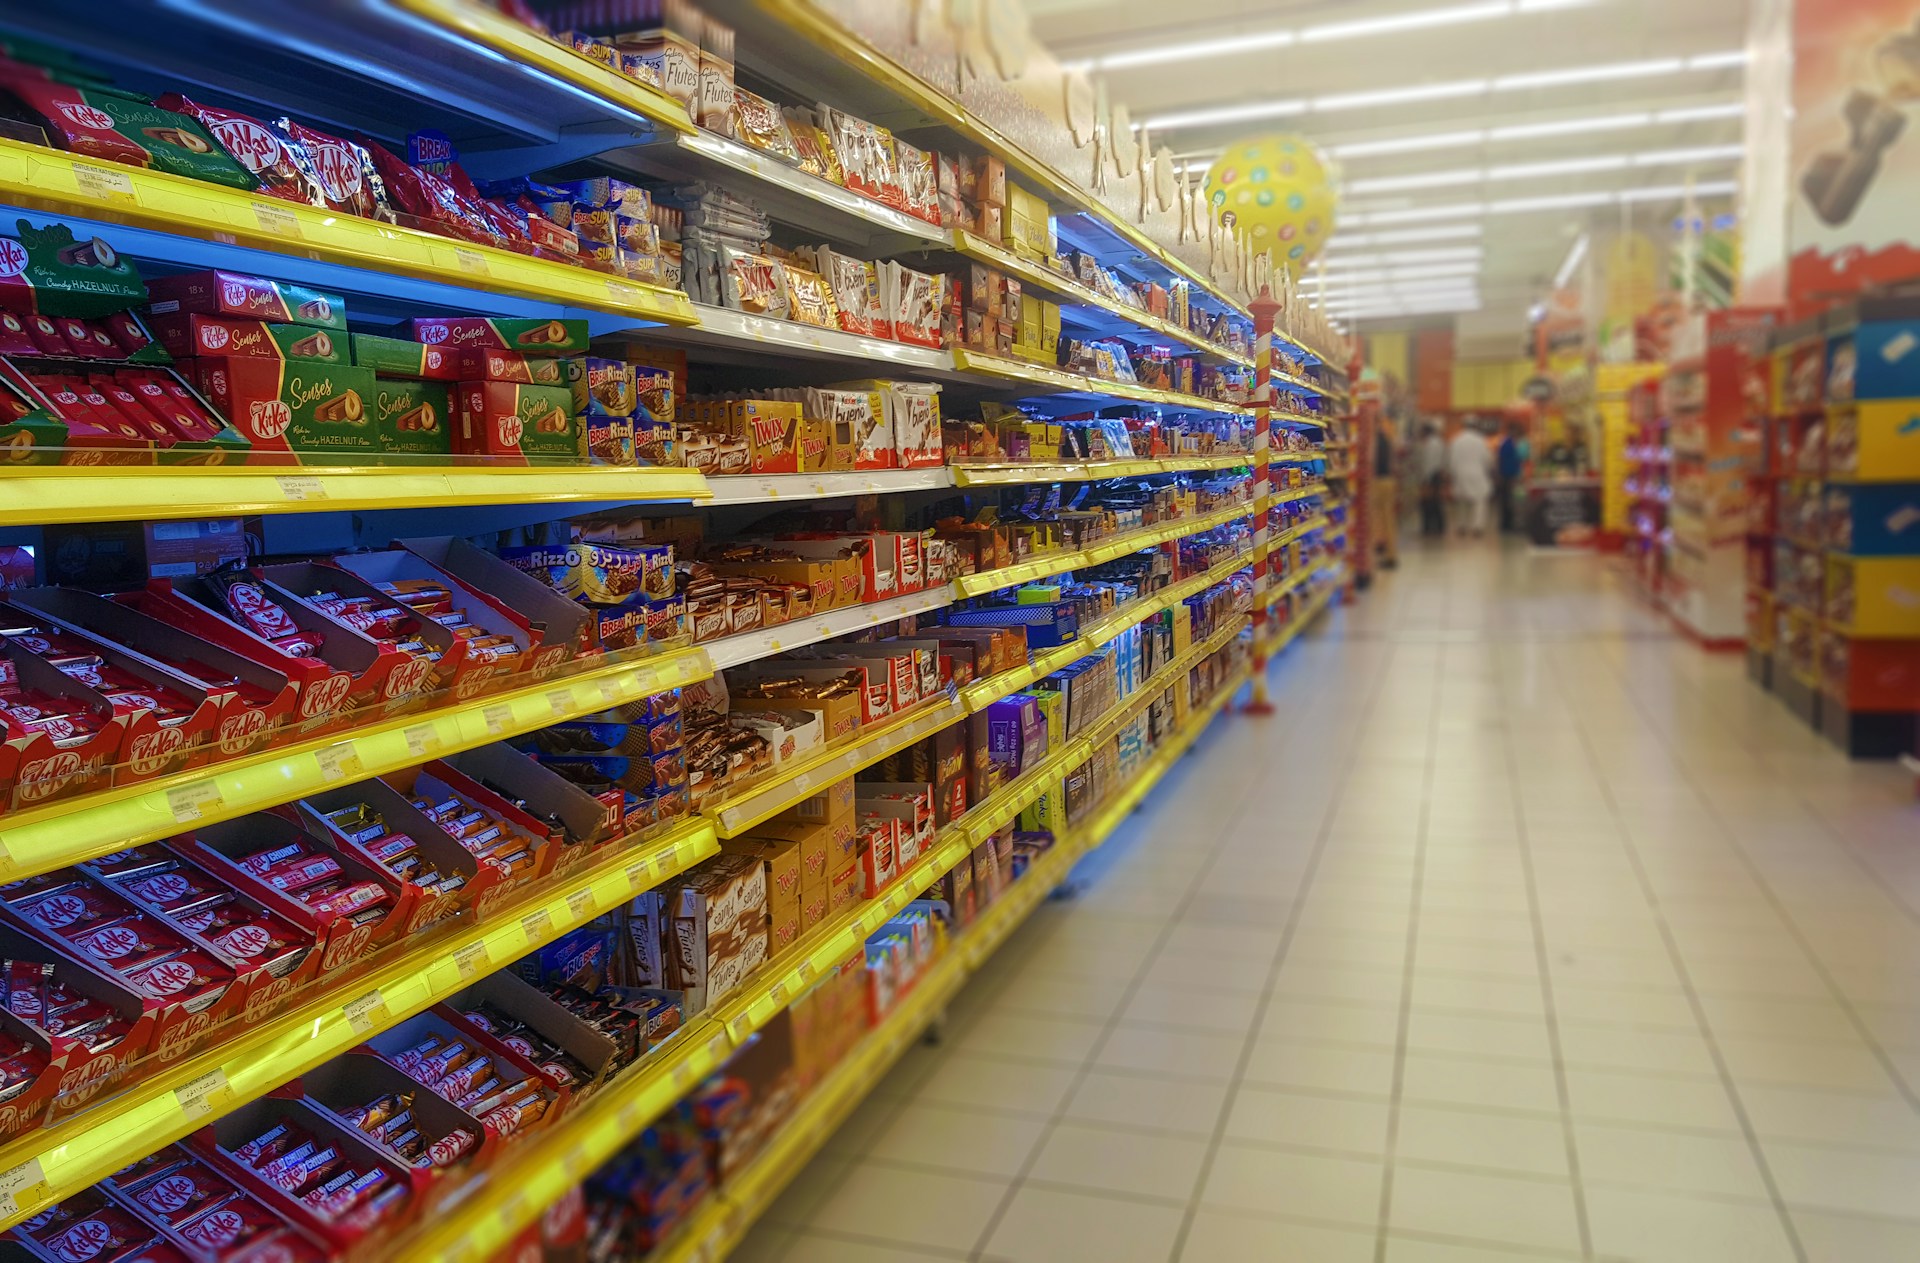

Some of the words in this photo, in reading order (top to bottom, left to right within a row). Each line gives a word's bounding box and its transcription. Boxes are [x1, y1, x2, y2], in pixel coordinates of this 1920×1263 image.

[667, 62, 698, 88] Flutes
[704, 81, 734, 104] Flutes
[69, 104, 107, 130] KitKat
[219, 123, 274, 169] KitKat
[417, 136, 450, 162] BREAK
[314, 146, 358, 198] KitKat
[590, 210, 611, 225] SUPA
[71, 279, 122, 294] HAZELNUT
[227, 284, 247, 305] KitKat
[248, 288, 275, 310] Senses
[206, 324, 229, 348] KitKat
[231, 329, 263, 351] Senses
[425, 325, 448, 344] KitKat
[452, 326, 486, 345] Senses
[290, 377, 334, 411] Senses
[378, 392, 412, 421] Senses
[257, 402, 289, 436] KitKat
[522, 396, 549, 424] Senses
[912, 405, 931, 429] bueno
[320, 436, 358, 446] HAZELNUT
[502, 419, 522, 446] KitKat
[770, 440, 784, 457] top
[239, 590, 294, 633] KitKat
[391, 660, 428, 697] KitKat
[305, 676, 347, 715] KitKat
[223, 712, 264, 750] KitKat
[136, 729, 180, 771] KitKat
[27, 753, 77, 798] KitKat
[360, 824, 385, 844] CHUNKY
[268, 843, 299, 863] CHUNKY
[145, 875, 185, 901] KitKat
[37, 898, 81, 928] KitKat
[356, 908, 385, 923] CHUNKY
[93, 929, 135, 958] KitKat
[229, 927, 266, 956] KitKat
[633, 923, 649, 963] Flutes
[678, 923, 695, 966] Flutes
[148, 963, 191, 994] KitKat
[567, 956, 584, 981] BIG
[248, 979, 290, 1022] KitKat
[162, 1013, 208, 1058] KitKat
[64, 1055, 114, 1105] KitKat
[257, 1124, 288, 1145] CHUNKY
[386, 1110, 412, 1133] CHUNKY
[393, 1130, 419, 1147] CHUNKY
[285, 1142, 315, 1166] CHUNKY
[306, 1148, 337, 1170] CHUNKY
[326, 1170, 357, 1192] CHUNKY
[352, 1167, 385, 1191] CHUNKY
[153, 1179, 191, 1211] KitKat
[65, 1223, 106, 1260] KitKat
[200, 1213, 239, 1246] KitKat
